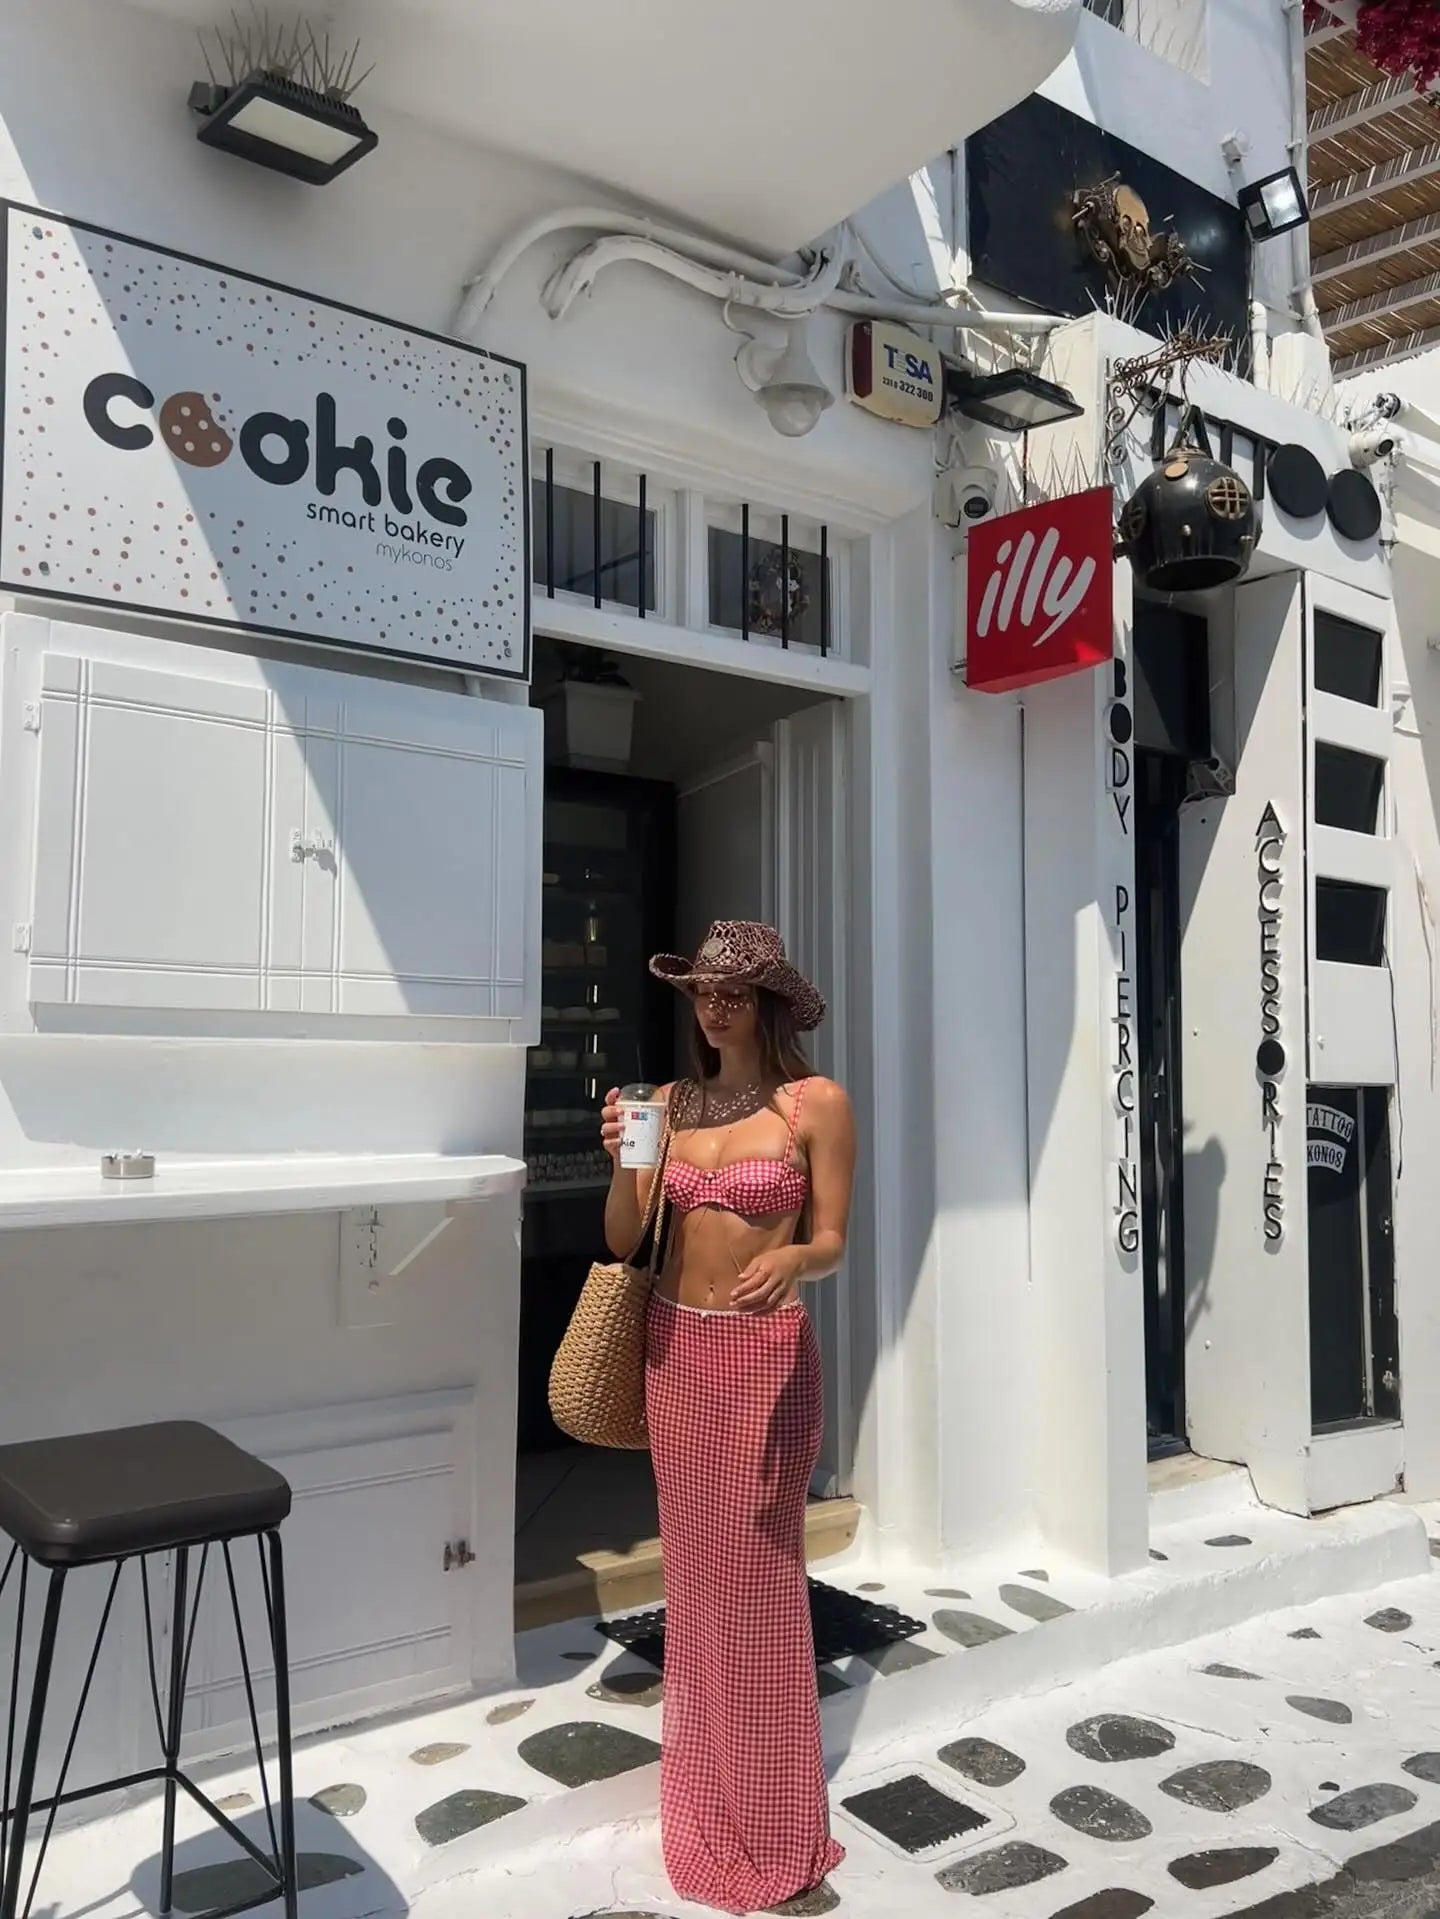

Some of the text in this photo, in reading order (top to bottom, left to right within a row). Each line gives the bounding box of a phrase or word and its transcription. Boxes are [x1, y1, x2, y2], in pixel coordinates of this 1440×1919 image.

[83, 372, 472, 527] cookie
[306, 503, 465, 558] smart bakery
[376, 543, 453, 572] mykonos
[975, 527, 1096, 647] illy
[1110, 657, 1140, 1253] BODY PIERCING
[1255, 800, 1285, 1241] ACCESSORIES
[1306, 1107, 1352, 1139] TATTOO
[1306, 1144, 1343, 1168] KONOS
